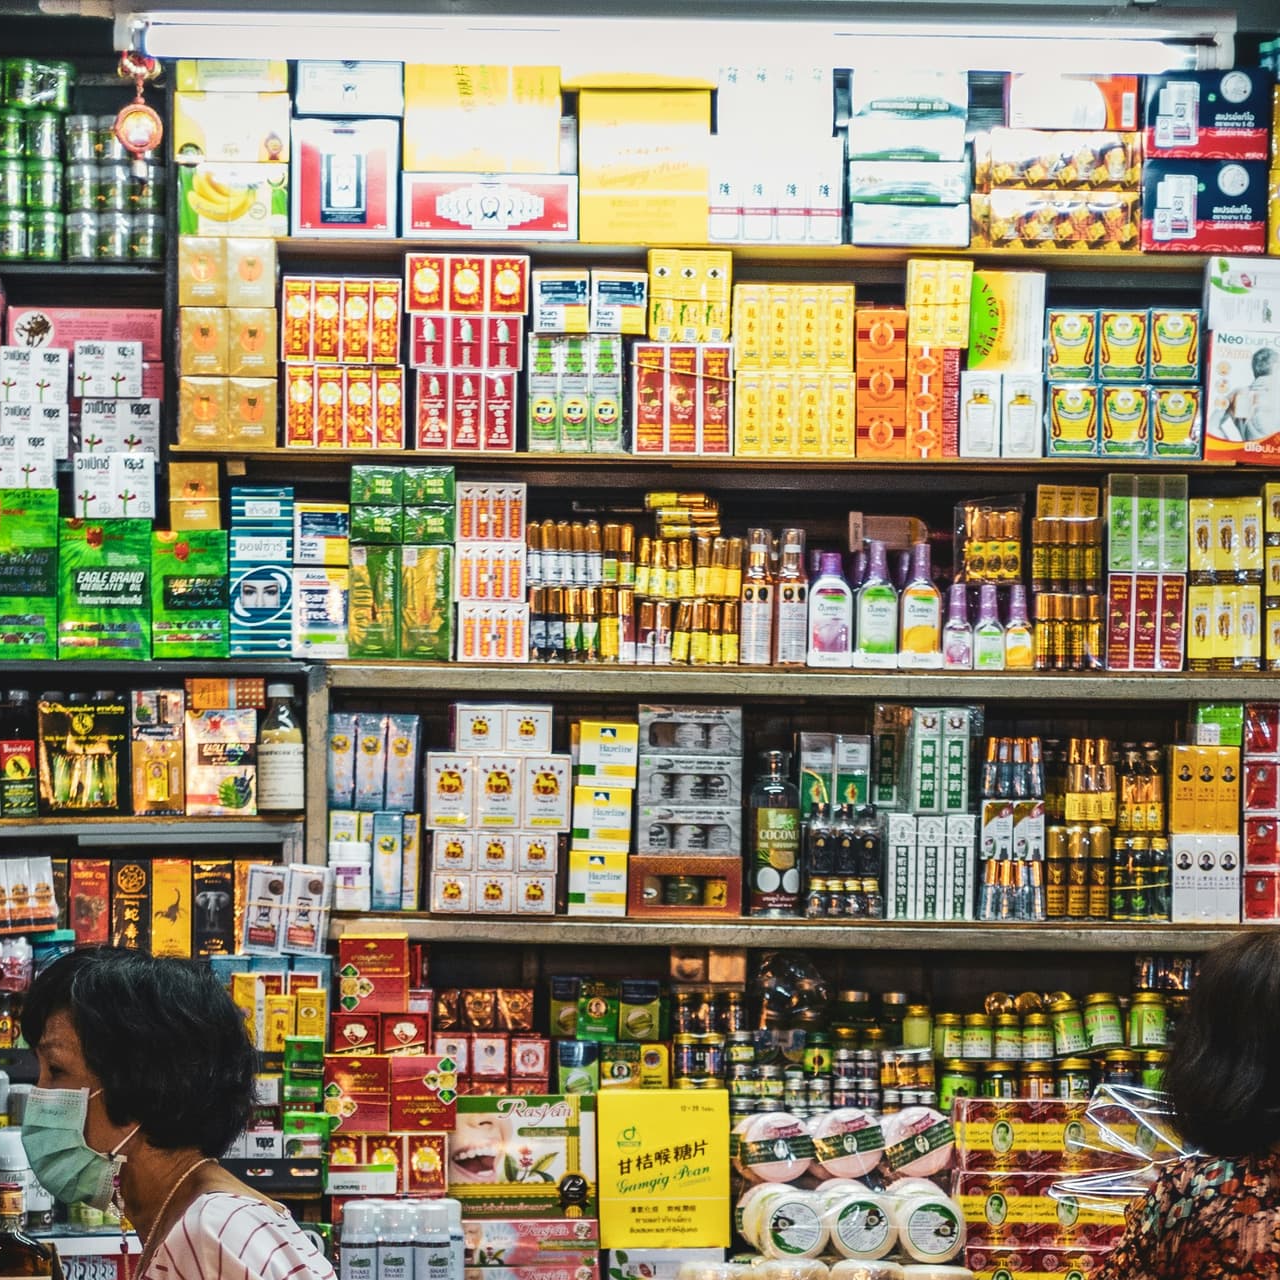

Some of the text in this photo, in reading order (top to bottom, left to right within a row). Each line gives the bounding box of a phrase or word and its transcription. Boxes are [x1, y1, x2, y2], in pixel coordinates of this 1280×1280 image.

[77, 572, 144, 583] EAGLE BRAND
[79, 583, 141, 591] MEDICATED OIL
[300, 590, 327, 605] Tear
[599, 744, 633, 753] Hazeline
[593, 808, 626, 817] Hazeline
[760, 829, 799, 841] COCONU
[588, 872, 622, 881] Hazeline
[497, 1099, 573, 1127] Rasyan
[618, 1140, 709, 1177] 甘桔喉糖片
[563, 1179, 580, 1192] 12
